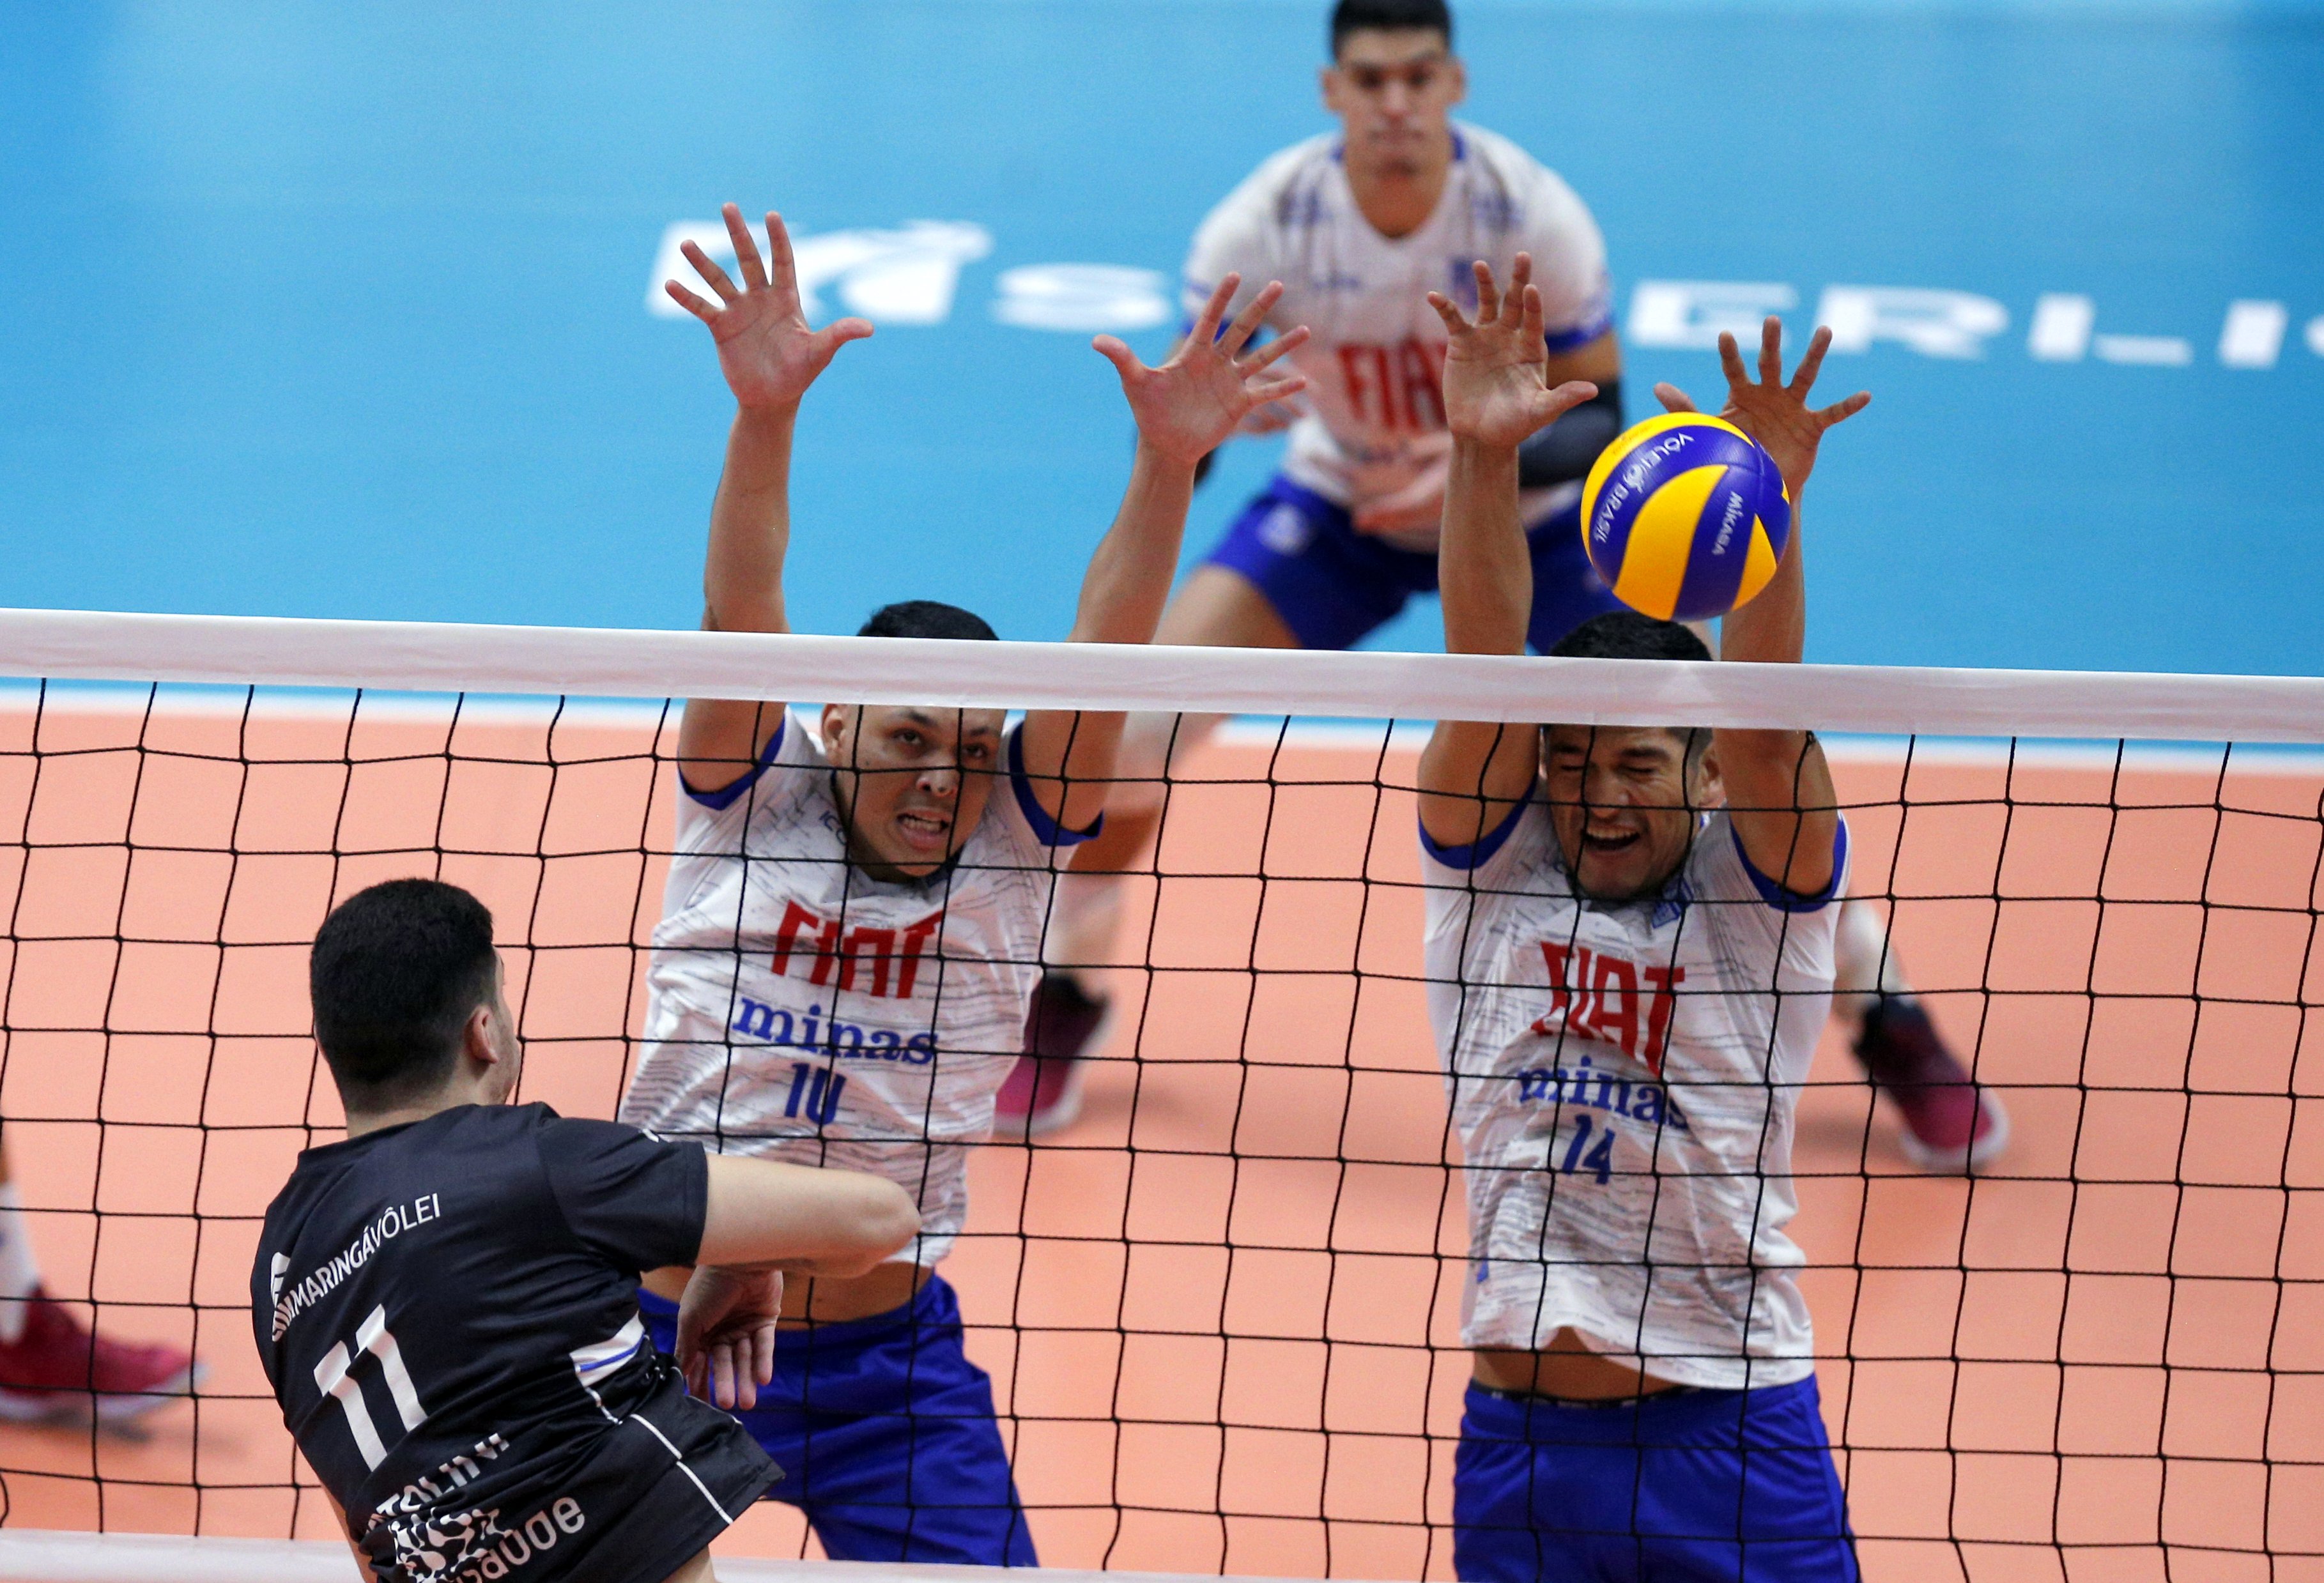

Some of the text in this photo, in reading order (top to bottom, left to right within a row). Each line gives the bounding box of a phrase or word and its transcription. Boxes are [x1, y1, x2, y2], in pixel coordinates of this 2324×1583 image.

[1337, 333, 1450, 431] FIA
[1594, 482, 1629, 543] BRASIL
[732, 997, 939, 1065] minas
[1530, 940, 1685, 1080] FIAT
[784, 1062, 847, 1126] 10
[1562, 1113, 1616, 1185] 14
[313, 1303, 429, 1472] 11
